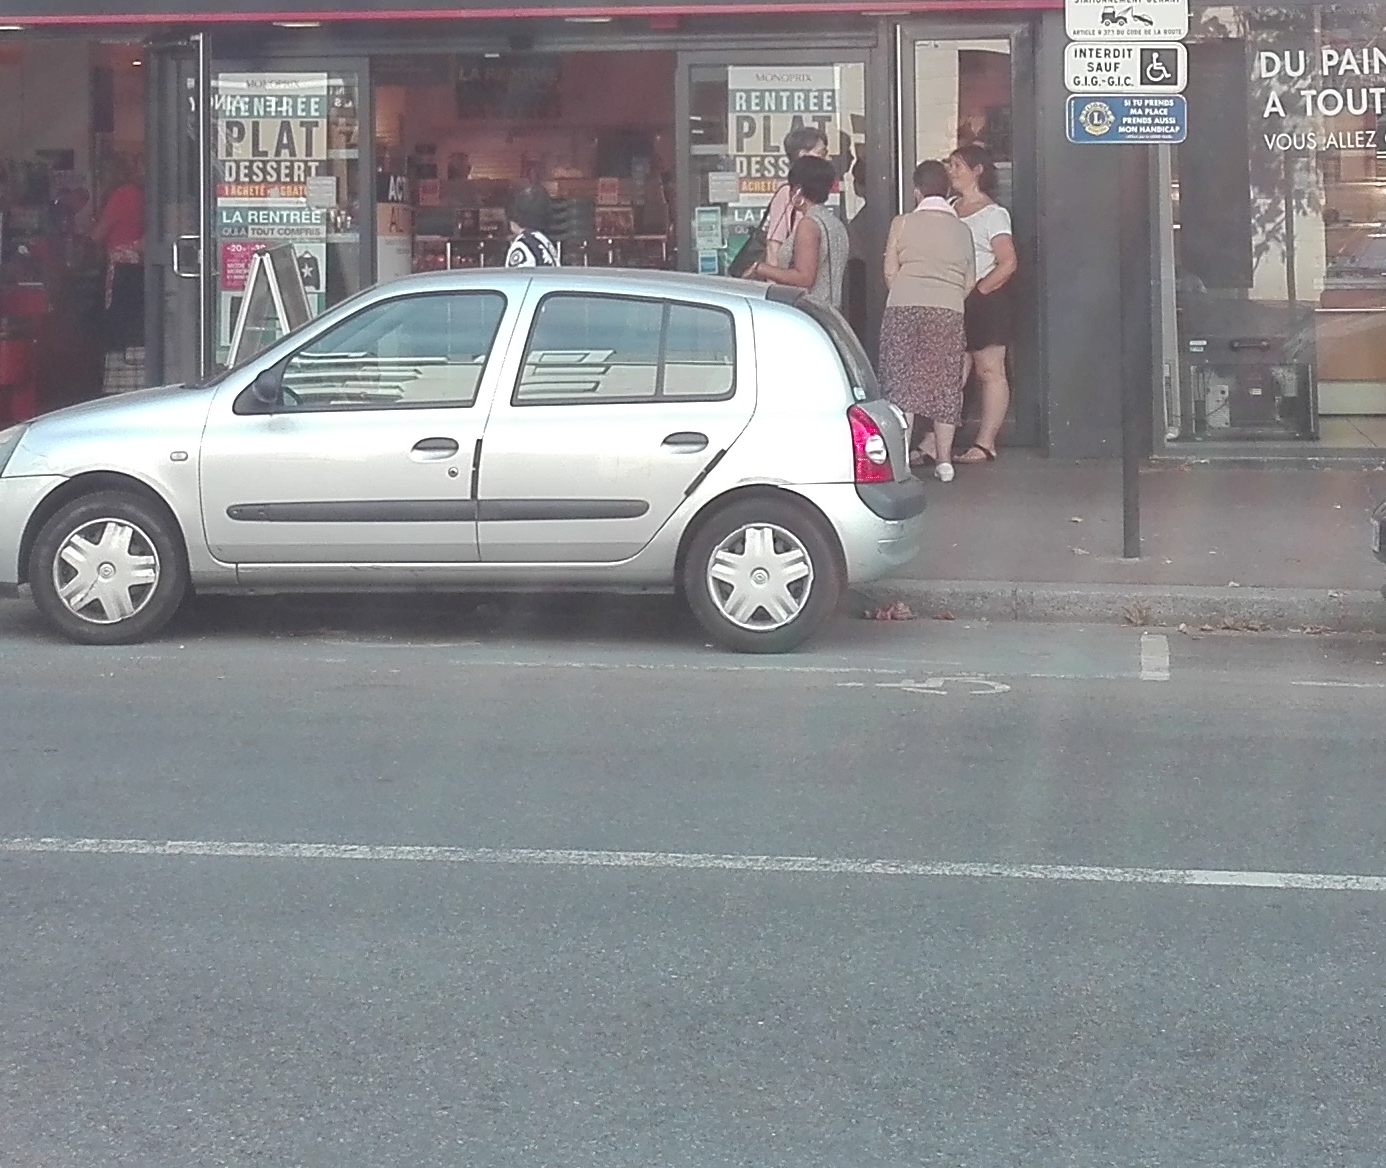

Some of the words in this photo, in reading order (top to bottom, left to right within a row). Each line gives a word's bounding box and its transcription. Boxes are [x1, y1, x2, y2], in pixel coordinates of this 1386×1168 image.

[1074, 48, 1133, 59] INTERDIT
[1086, 62, 1121, 72] SAUF
[1259, 49, 1306, 79] DU
[754, 73, 813, 83] MONOPRIX
[224, 93, 321, 117] RENTRÉE
[1133, 99, 1143, 107] TU
[1144, 99, 1174, 107] PRENDS
[1130, 108, 1142, 116] MA
[1144, 108, 1168, 116] PLACE
[224, 120, 320, 158] PLAT
[1264, 132, 1317, 151] VOUS
[1326, 130, 1377, 149] ALLEZ
[224, 161, 320, 183] DESSERT
[735, 156, 790, 178] DESS
[222, 211, 243, 224] LA
[247, 207, 322, 224] RENTRÉE
[734, 209, 755, 222] LA
[250, 227, 275, 236] TOUT
[277, 227, 321, 236] COMPRIS
